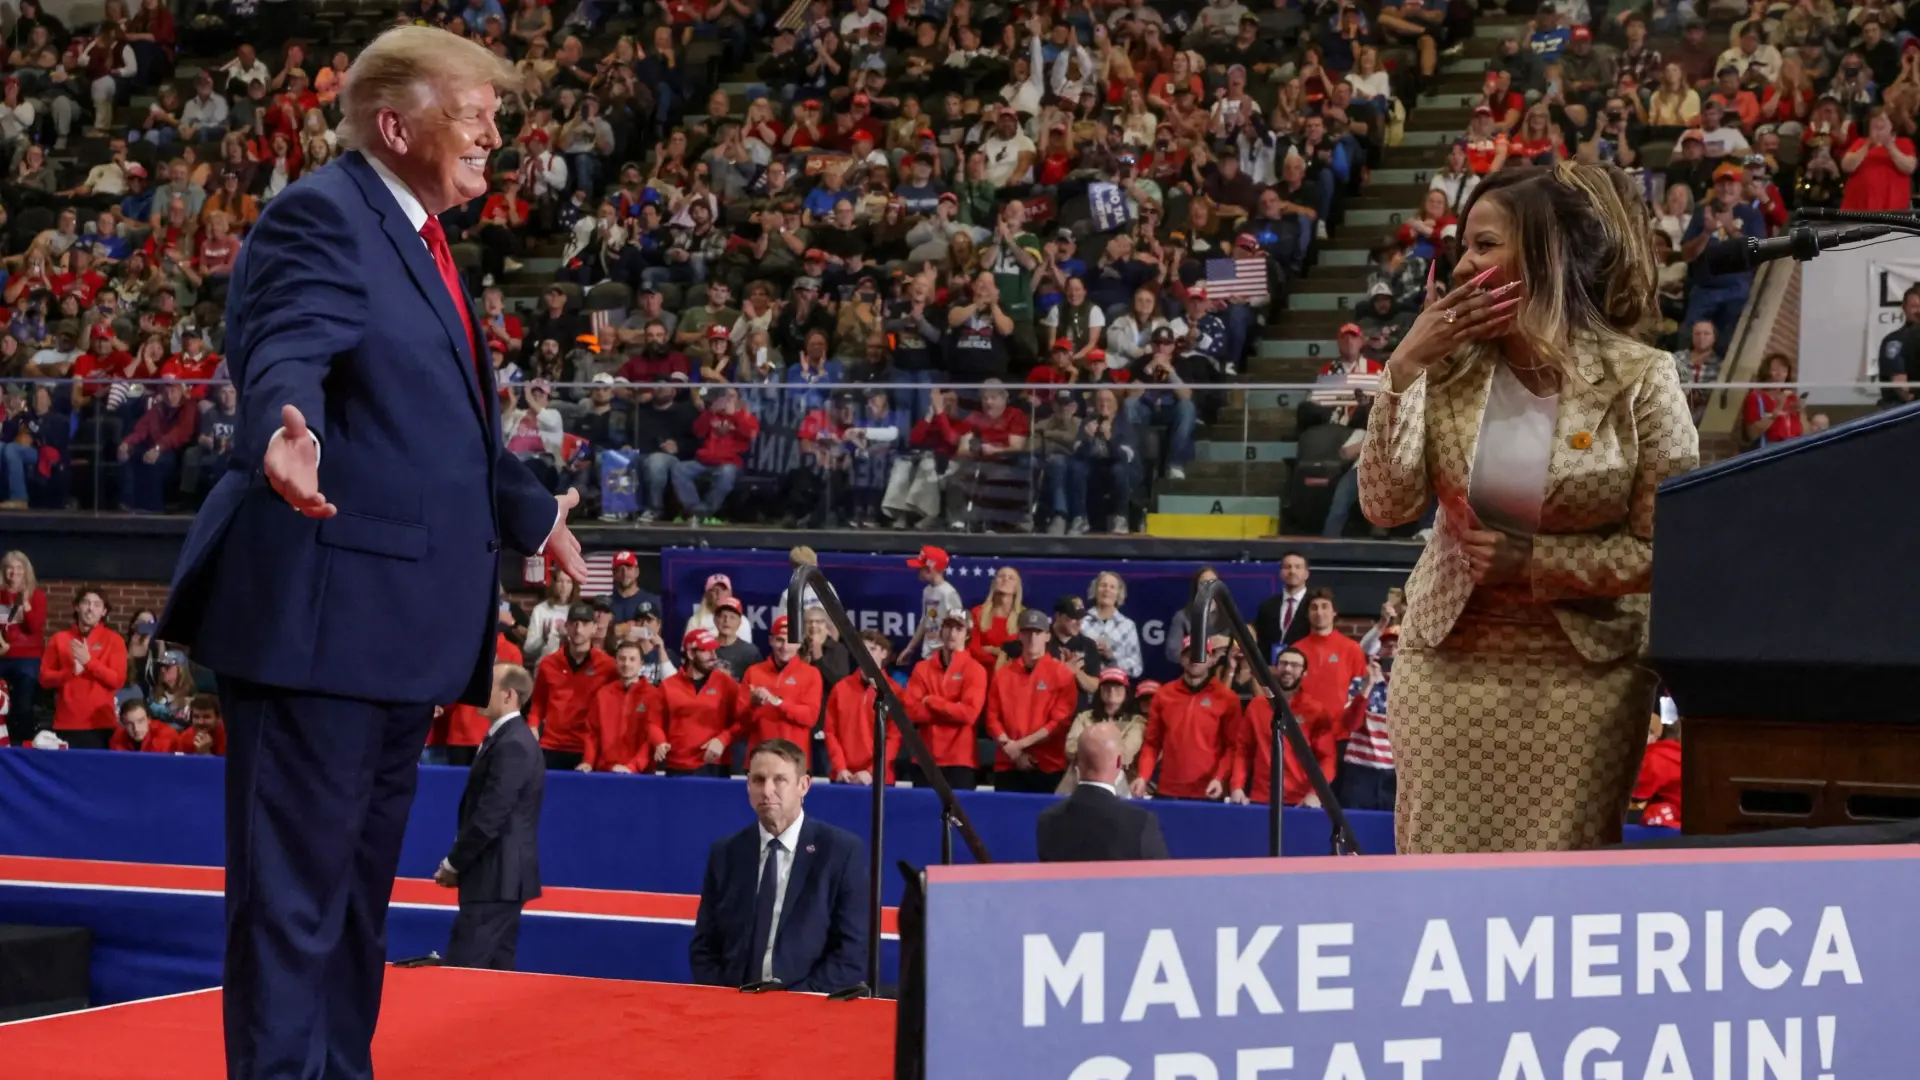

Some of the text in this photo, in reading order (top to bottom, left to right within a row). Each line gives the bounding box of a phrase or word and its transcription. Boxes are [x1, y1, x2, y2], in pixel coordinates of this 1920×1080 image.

[1415, 171, 1426, 183] H
[1109, 185, 1126, 224] NO TAX
[1308, 344, 1320, 357] D
[1277, 393, 1289, 406] C
[1246, 446, 1257, 460] B
[1211, 500, 1224, 514] A
[1023, 905, 1863, 1027] MAKE AMERICA
